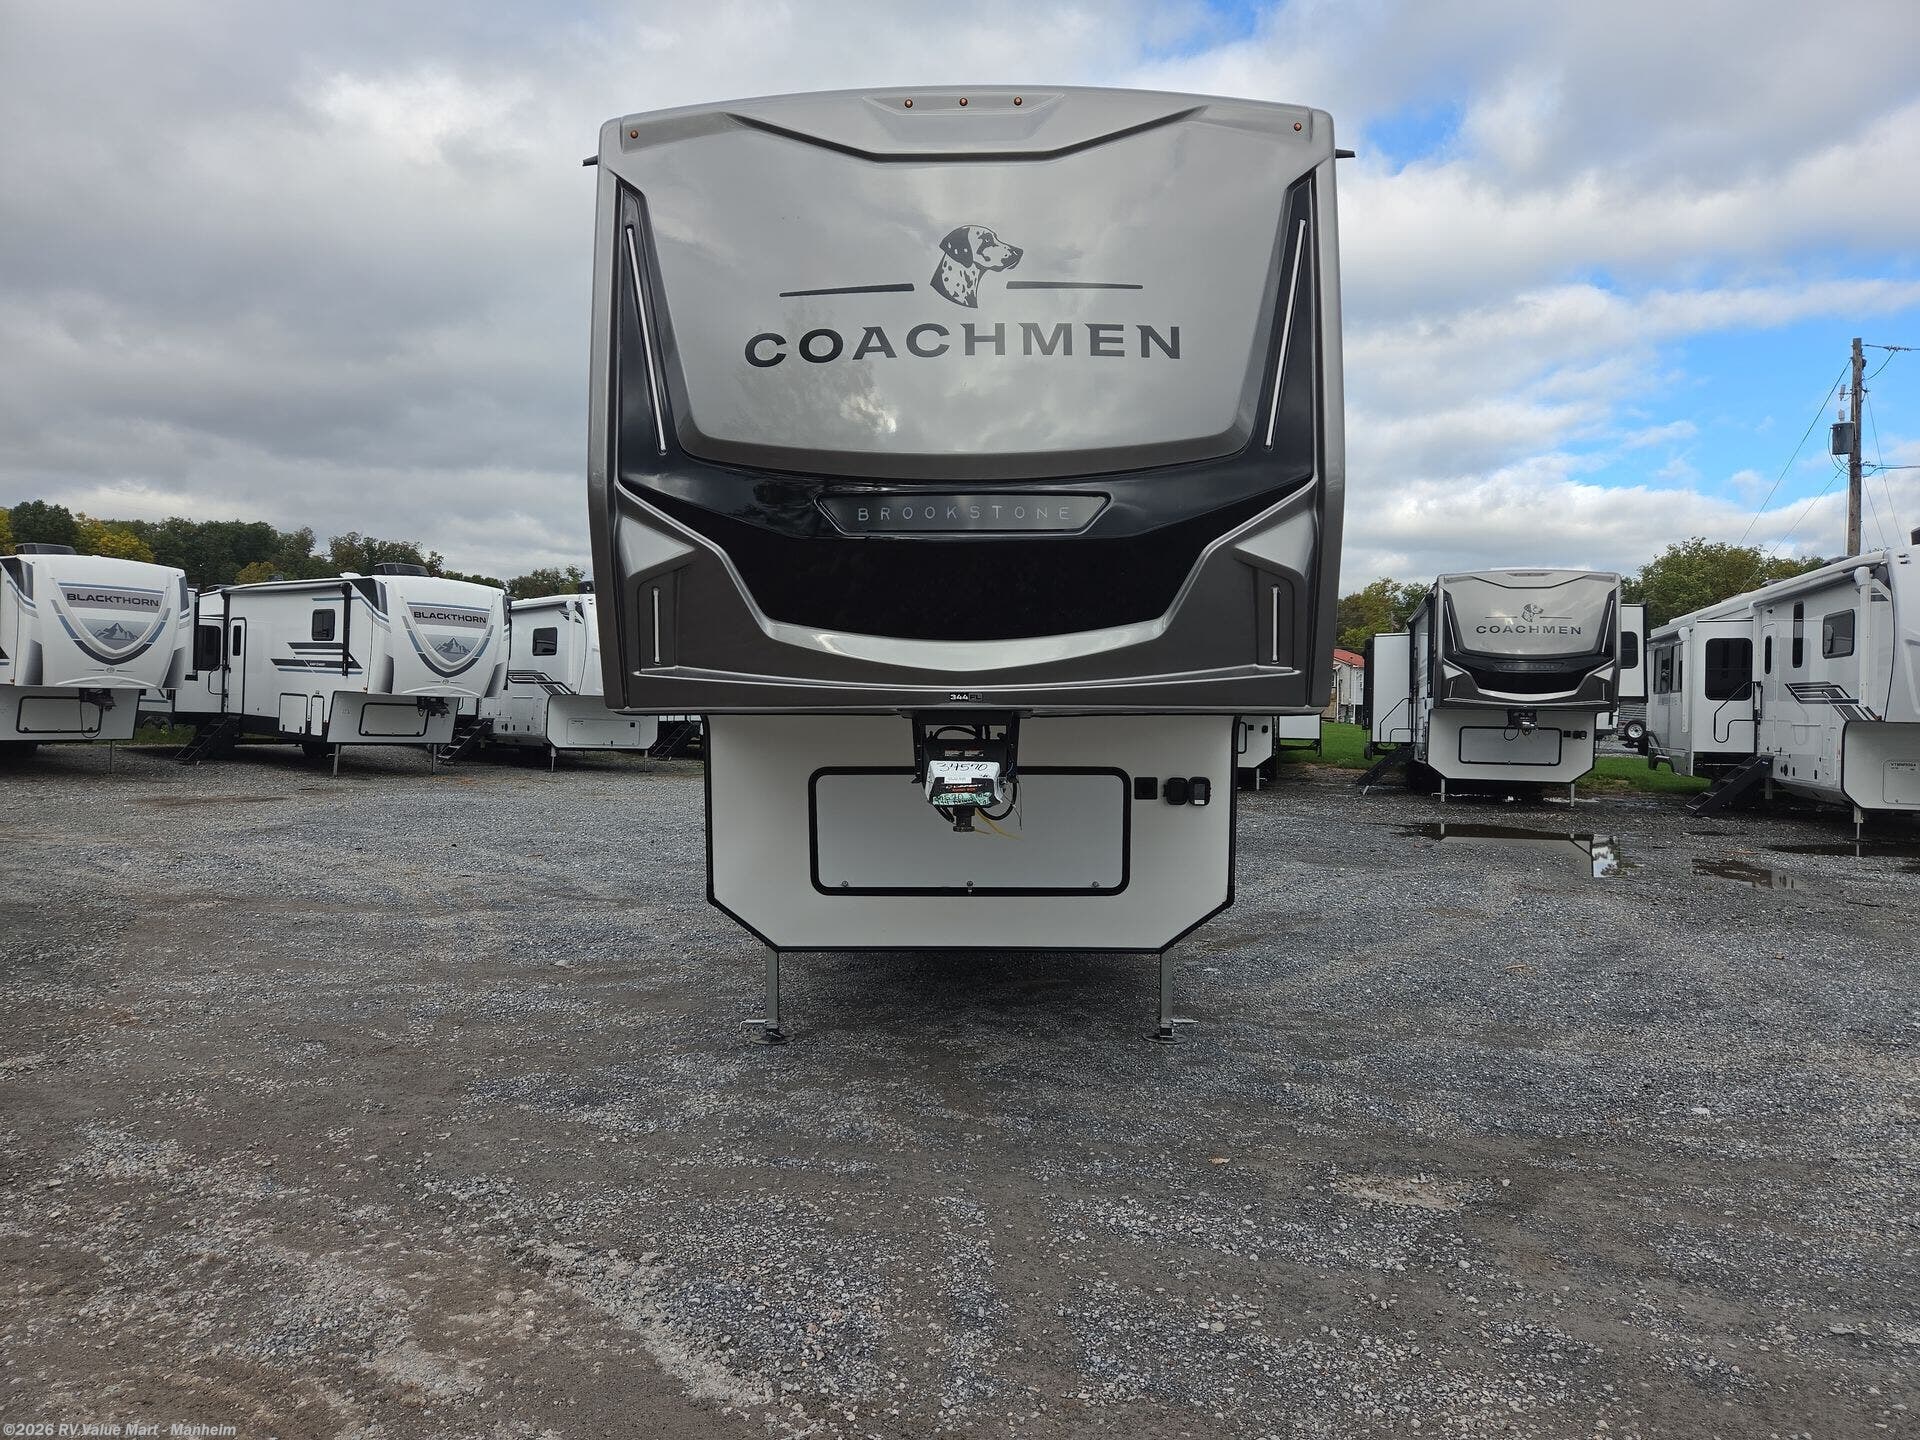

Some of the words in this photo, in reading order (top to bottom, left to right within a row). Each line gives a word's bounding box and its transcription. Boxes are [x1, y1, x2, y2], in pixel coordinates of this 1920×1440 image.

[745, 322, 1181, 367] COACHMEN
[858, 506, 1071, 521] BROOKSTONE
[66, 593, 159, 607] BLACKTHORN
[413, 611, 487, 624] BLACKTHORN
[1476, 625, 1582, 635] COACHMEN
